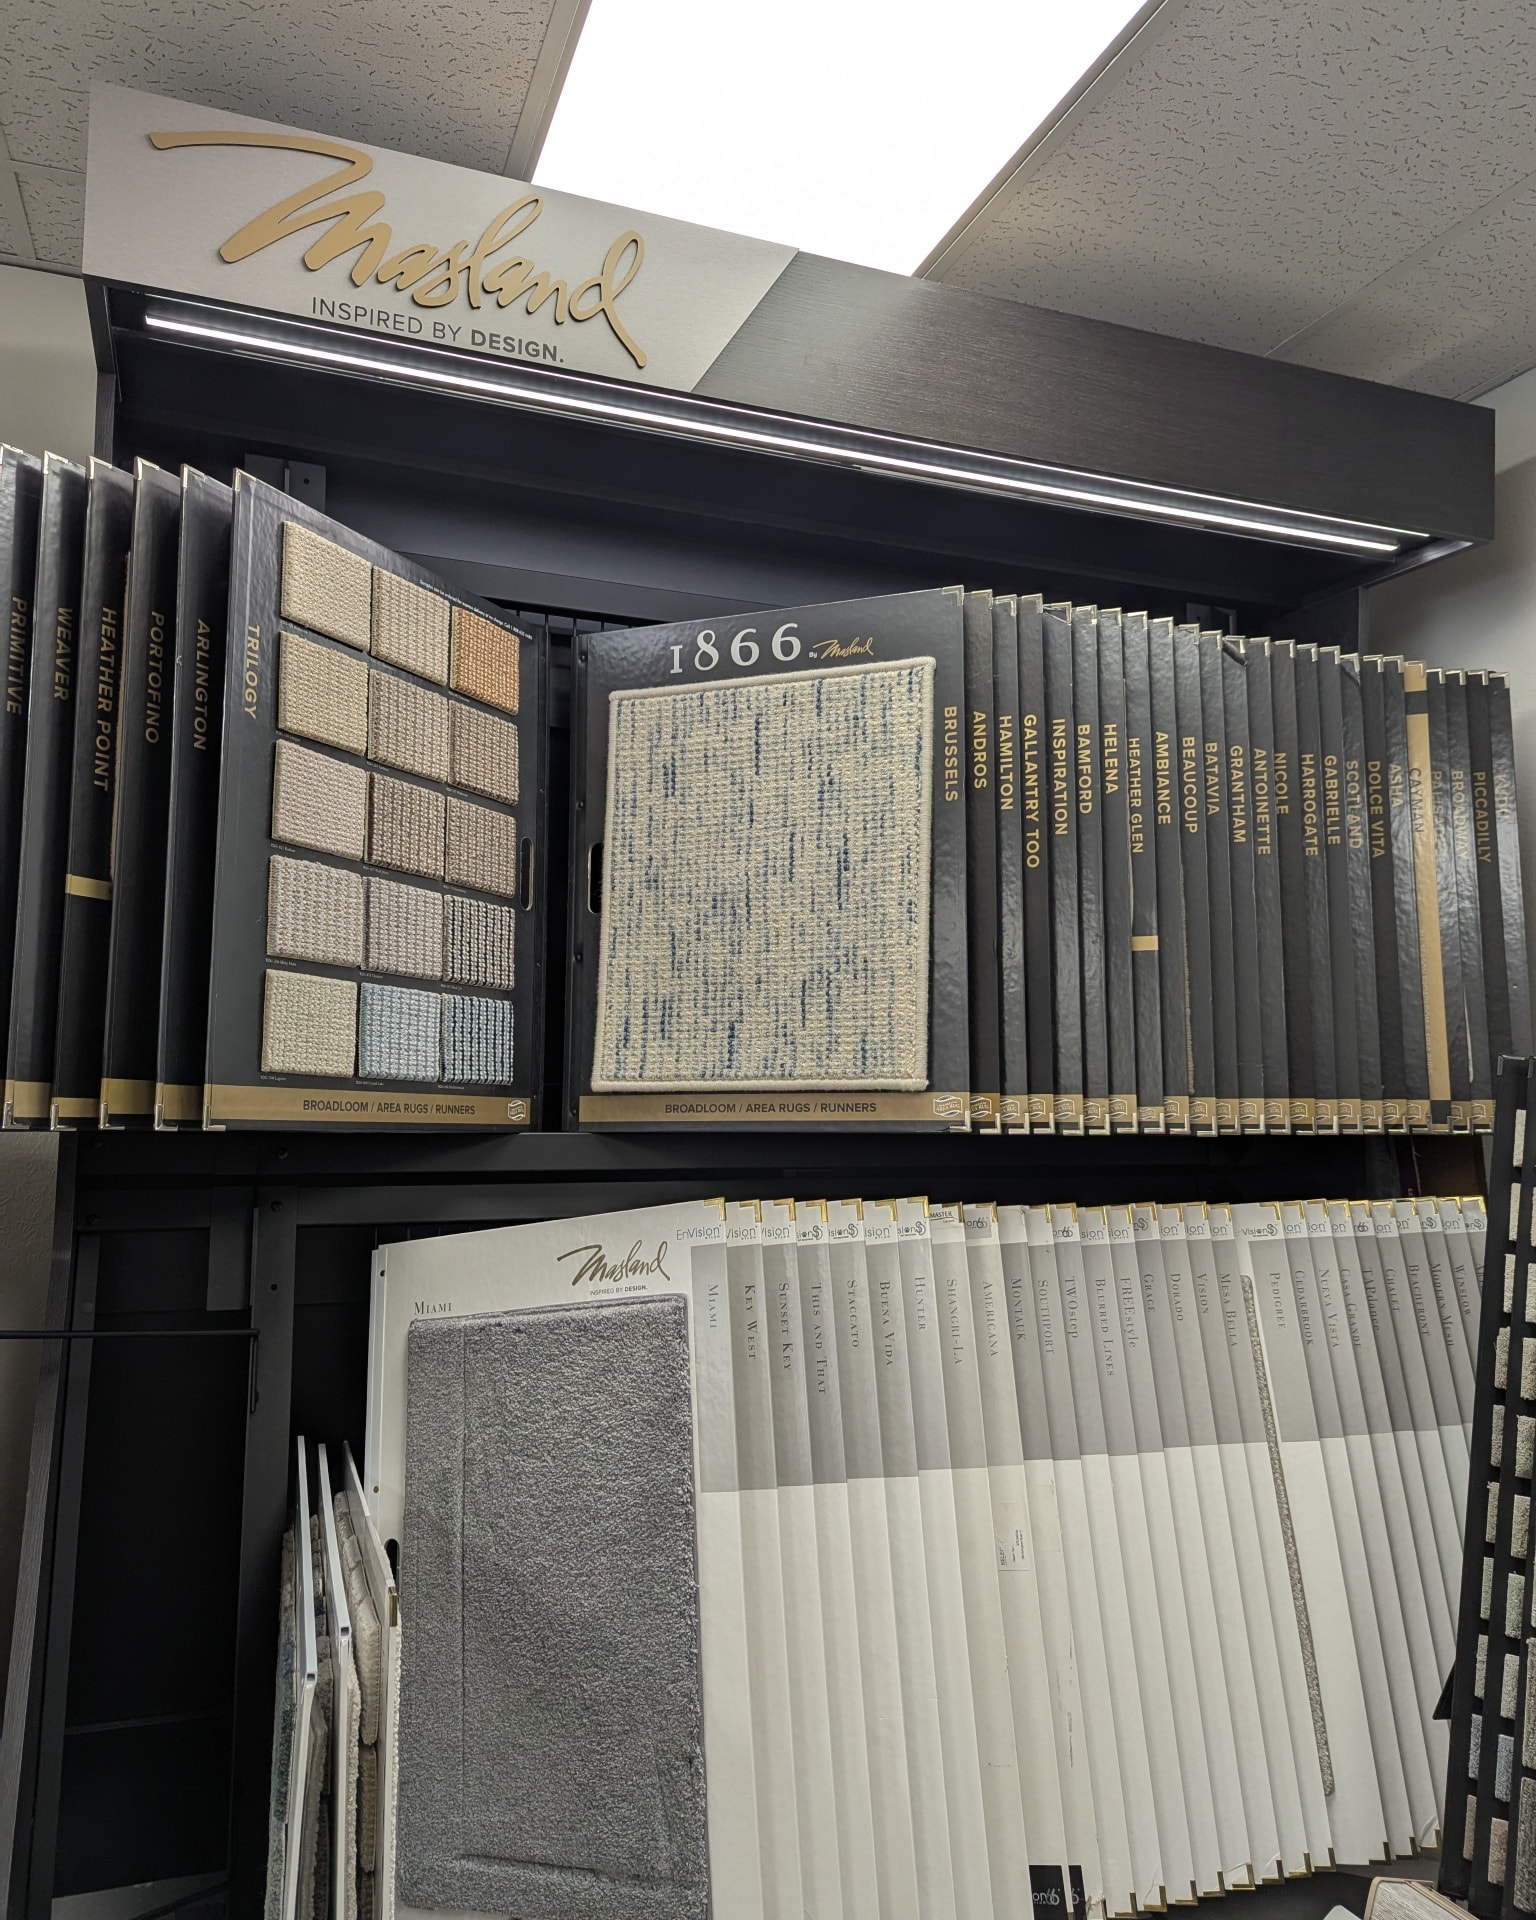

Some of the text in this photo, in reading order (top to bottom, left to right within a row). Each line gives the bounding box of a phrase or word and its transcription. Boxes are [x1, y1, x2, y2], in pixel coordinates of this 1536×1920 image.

[149, 131, 647, 368] Masland
[310, 296, 564, 363] INSPIRED BY DESIGN.
[6, 595, 29, 716] PRIMITIVE
[54, 606, 74, 701] WEAVER
[144, 610, 164, 746] PORTOFINO
[192, 617, 211, 752] ARLINGTON
[243, 623, 261, 720] TRILOGY
[669, 622, 801, 674] 1866
[812, 636, 874, 660] Masland
[92, 606, 118, 792] HEATHER POINT
[944, 705, 959, 803] BRUSSELS
[973, 711, 988, 790] ANDROS
[999, 714, 1014, 812] HAMILTON
[1023, 713, 1040, 870] GALLANTRY TOO
[1052, 718, 1068, 836] INSPIRATION
[1077, 723, 1092, 815] BAMFORD
[1103, 723, 1119, 796] HELENA
[1128, 736, 1144, 854] HEATHER GLEN
[1155, 731, 1172, 826] AMBIANCE
[1182, 736, 1198, 834] BEAUCOUP
[1204, 741, 1220, 817] BATAVIA
[1230, 744, 1246, 844] GRANTHAM
[1274, 752, 1289, 816] NICOLE
[1390, 763, 1404, 808] ASHA
[1253, 748, 1271, 857] ANTOINETTE
[1302, 753, 1318, 858] HARROGATE
[1324, 754, 1341, 846] GABRIELLE
[1346, 760, 1362, 850] SCOTLAND
[1368, 760, 1386, 858] DOLCE VITA
[1408, 767, 1424, 834] CAYMAN
[1452, 770, 1469, 860] BROADWAY
[1472, 771, 1492, 864] PICCADILLY
[303, 1100, 369, 1113] BROADLOOM
[377, 1102, 402, 1114] AREA
[404, 1103, 429, 1114] RUGS
[436, 1104, 476, 1116] RUNNERS
[664, 1103, 736, 1114] BROADLOOM
[746, 1102, 776, 1114] AREA
[778, 1102, 811, 1114] RUGS
[820, 1102, 877, 1113] RUNNERS
[556, 1240, 670, 1286] Masland
